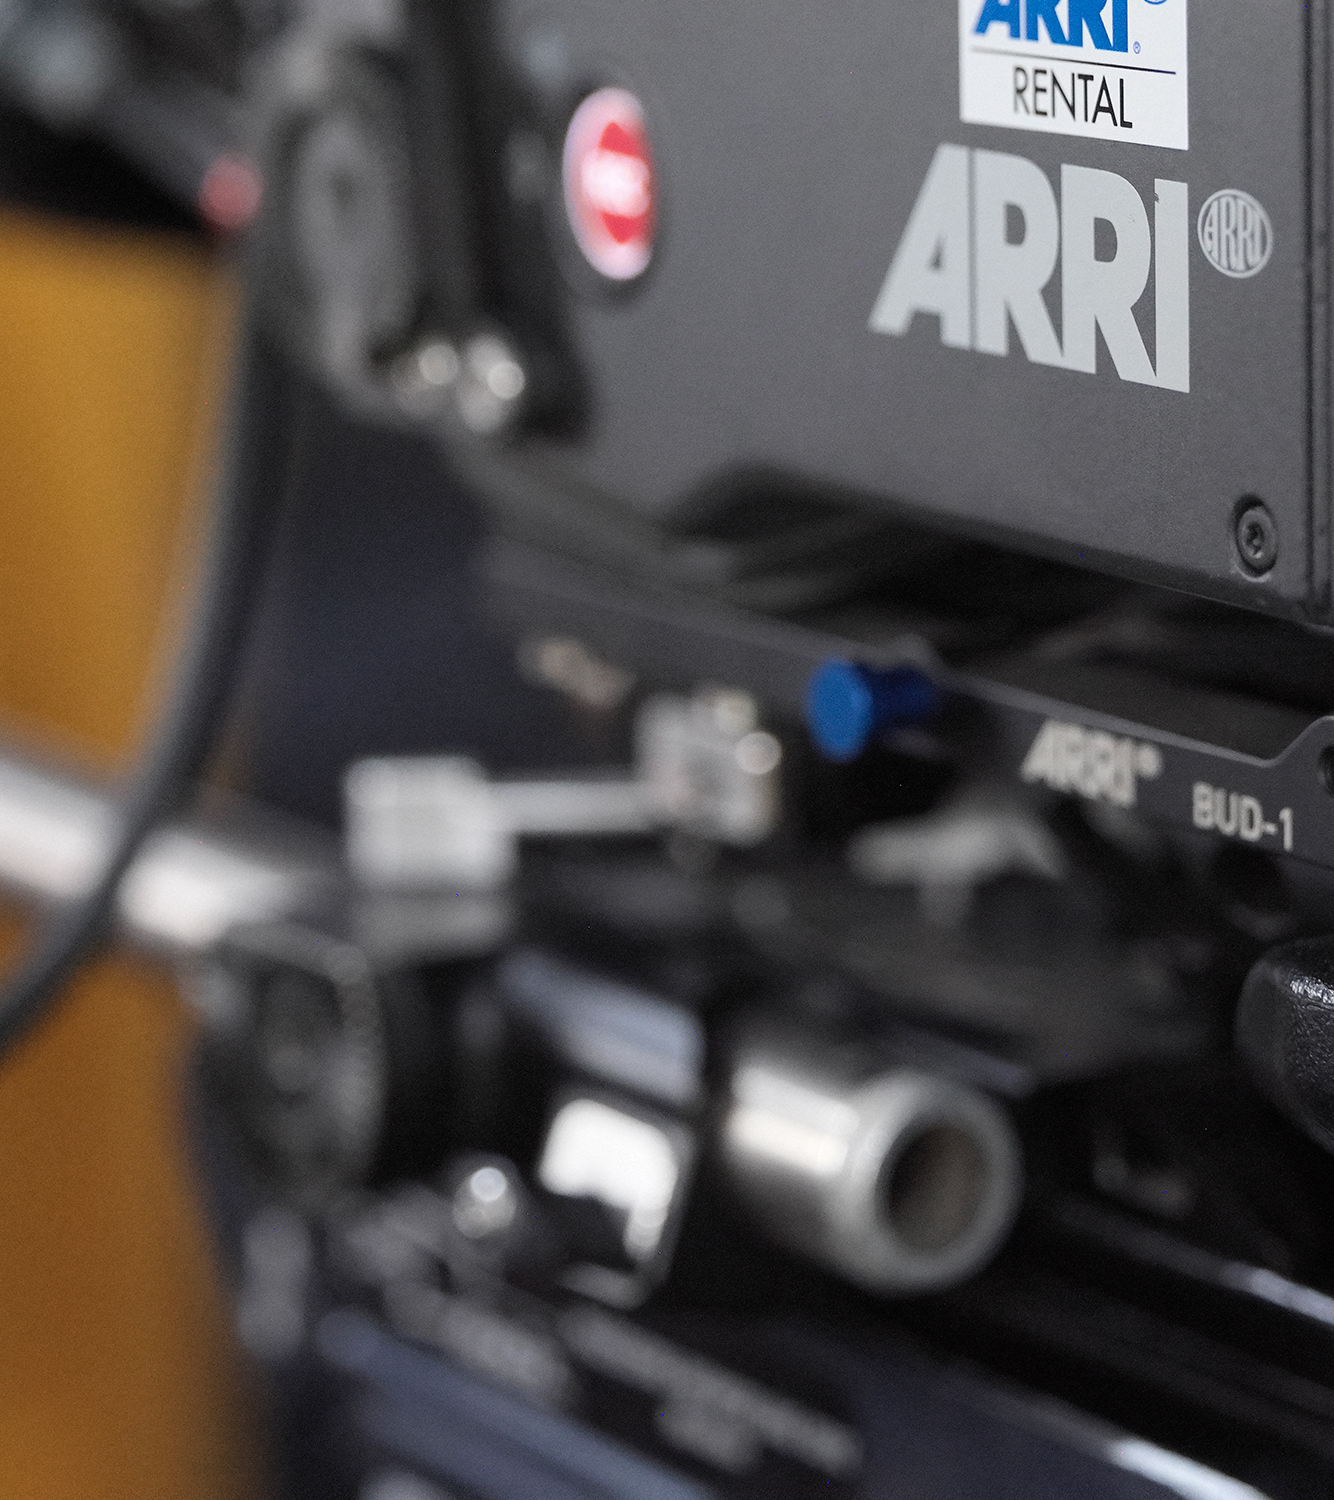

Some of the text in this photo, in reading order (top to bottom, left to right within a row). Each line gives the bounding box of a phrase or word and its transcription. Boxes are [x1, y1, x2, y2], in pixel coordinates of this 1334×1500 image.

[1012, 64, 1134, 130] RENTAL
[868, 142, 1267, 394] ARRI ARRI
[1192, 780, 1294, 852] BUD-1
